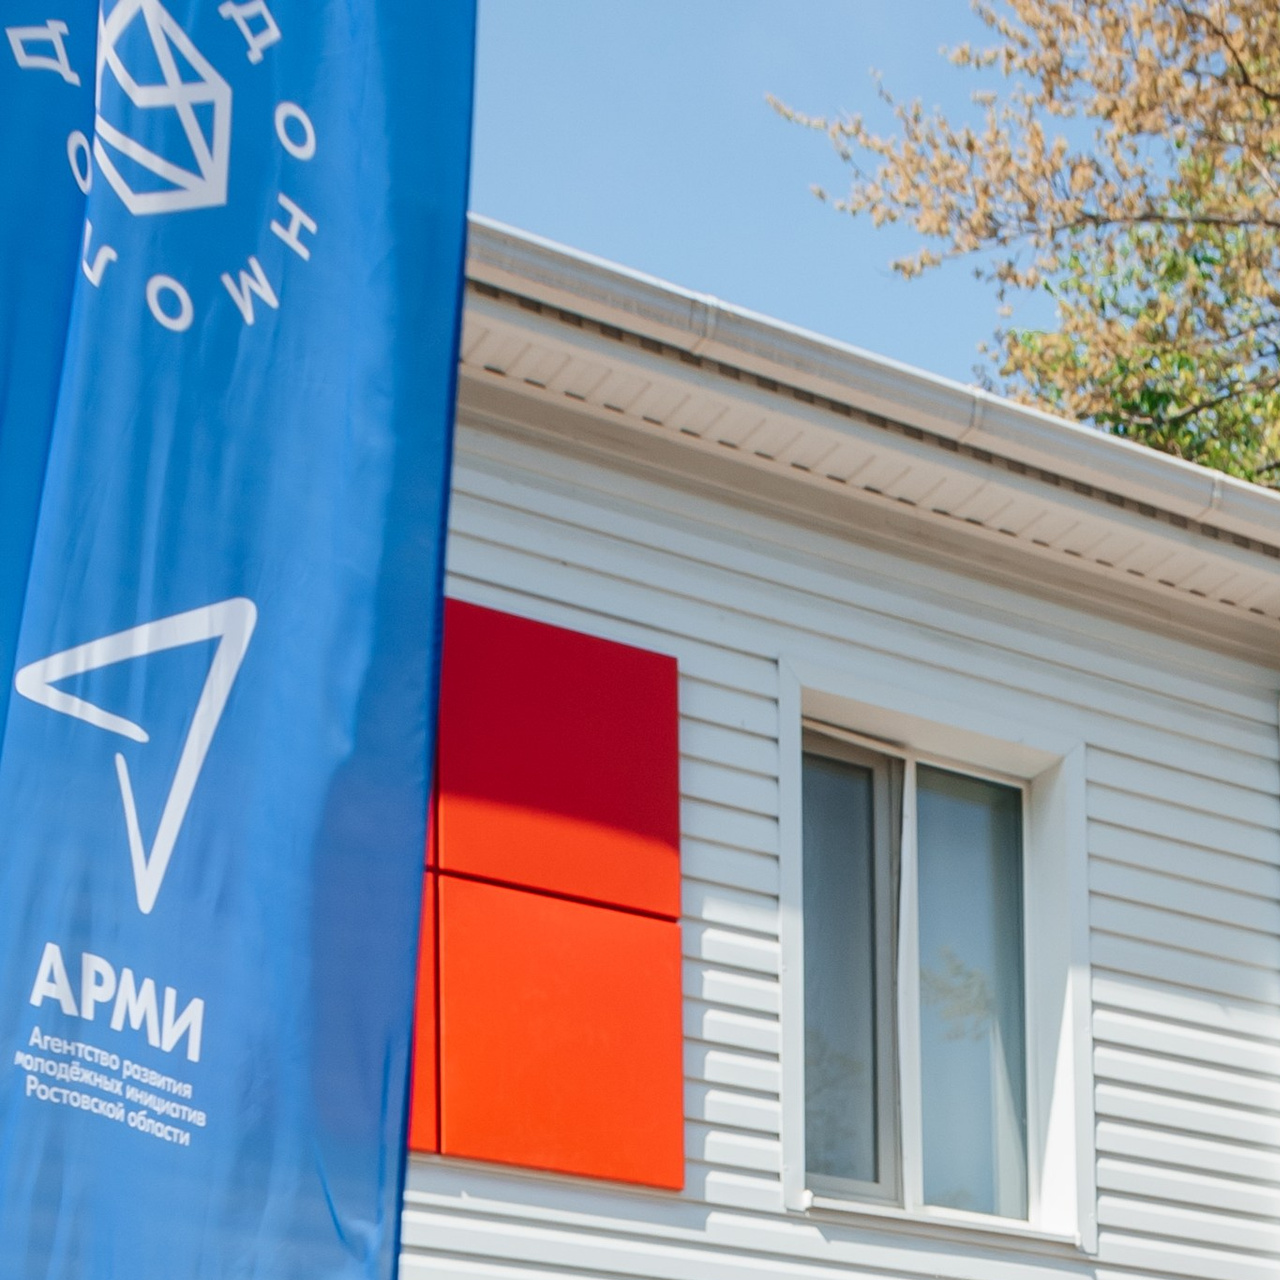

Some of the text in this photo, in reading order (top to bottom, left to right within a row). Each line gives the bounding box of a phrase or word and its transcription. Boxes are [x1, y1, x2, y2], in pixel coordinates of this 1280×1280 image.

[29, 942, 205, 1063] АРМИ
[14, 1050, 207, 1127] молодёжных инициатив
[29, 1026, 193, 1100] Агентство развития
[26, 1074, 190, 1146] Ростовской области
